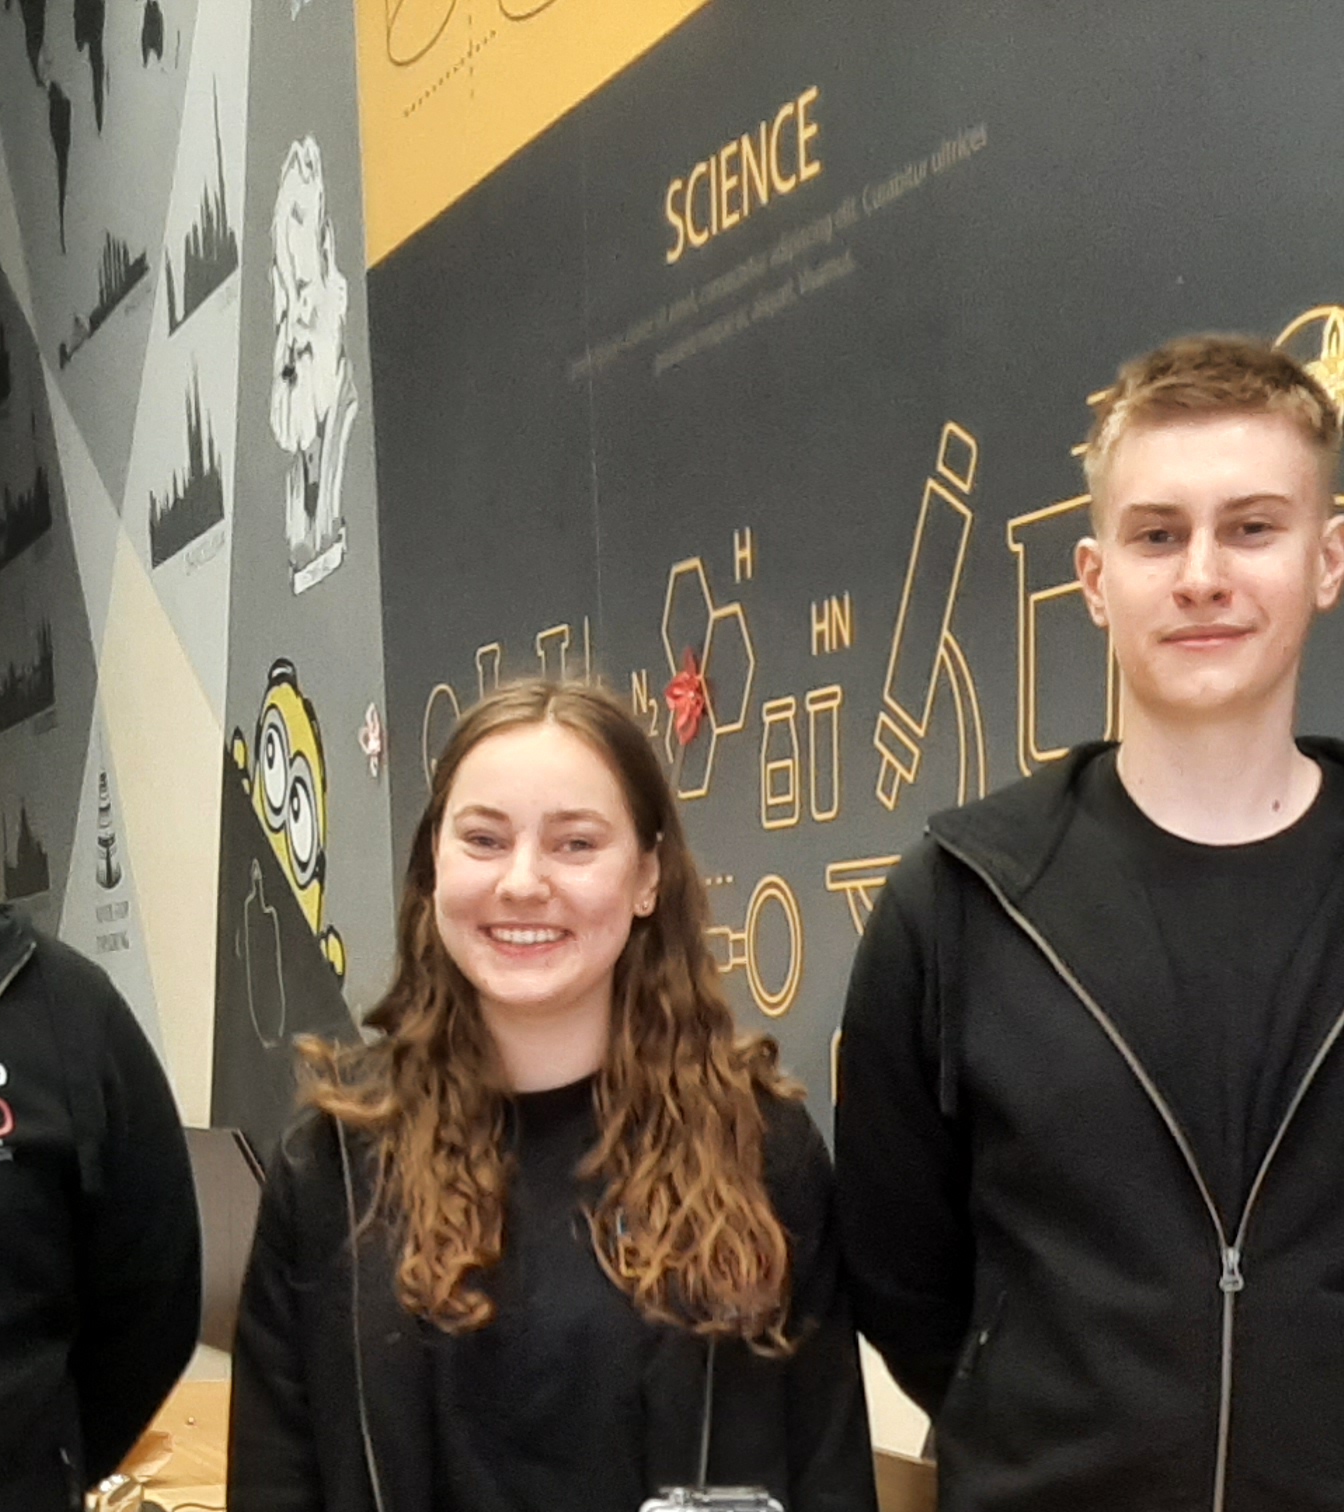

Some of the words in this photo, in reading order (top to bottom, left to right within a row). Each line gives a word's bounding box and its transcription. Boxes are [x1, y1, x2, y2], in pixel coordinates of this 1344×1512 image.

[665, 86, 821, 264] SCIENCE
[734, 526, 752, 584] H
[811, 590, 850, 656] HN
